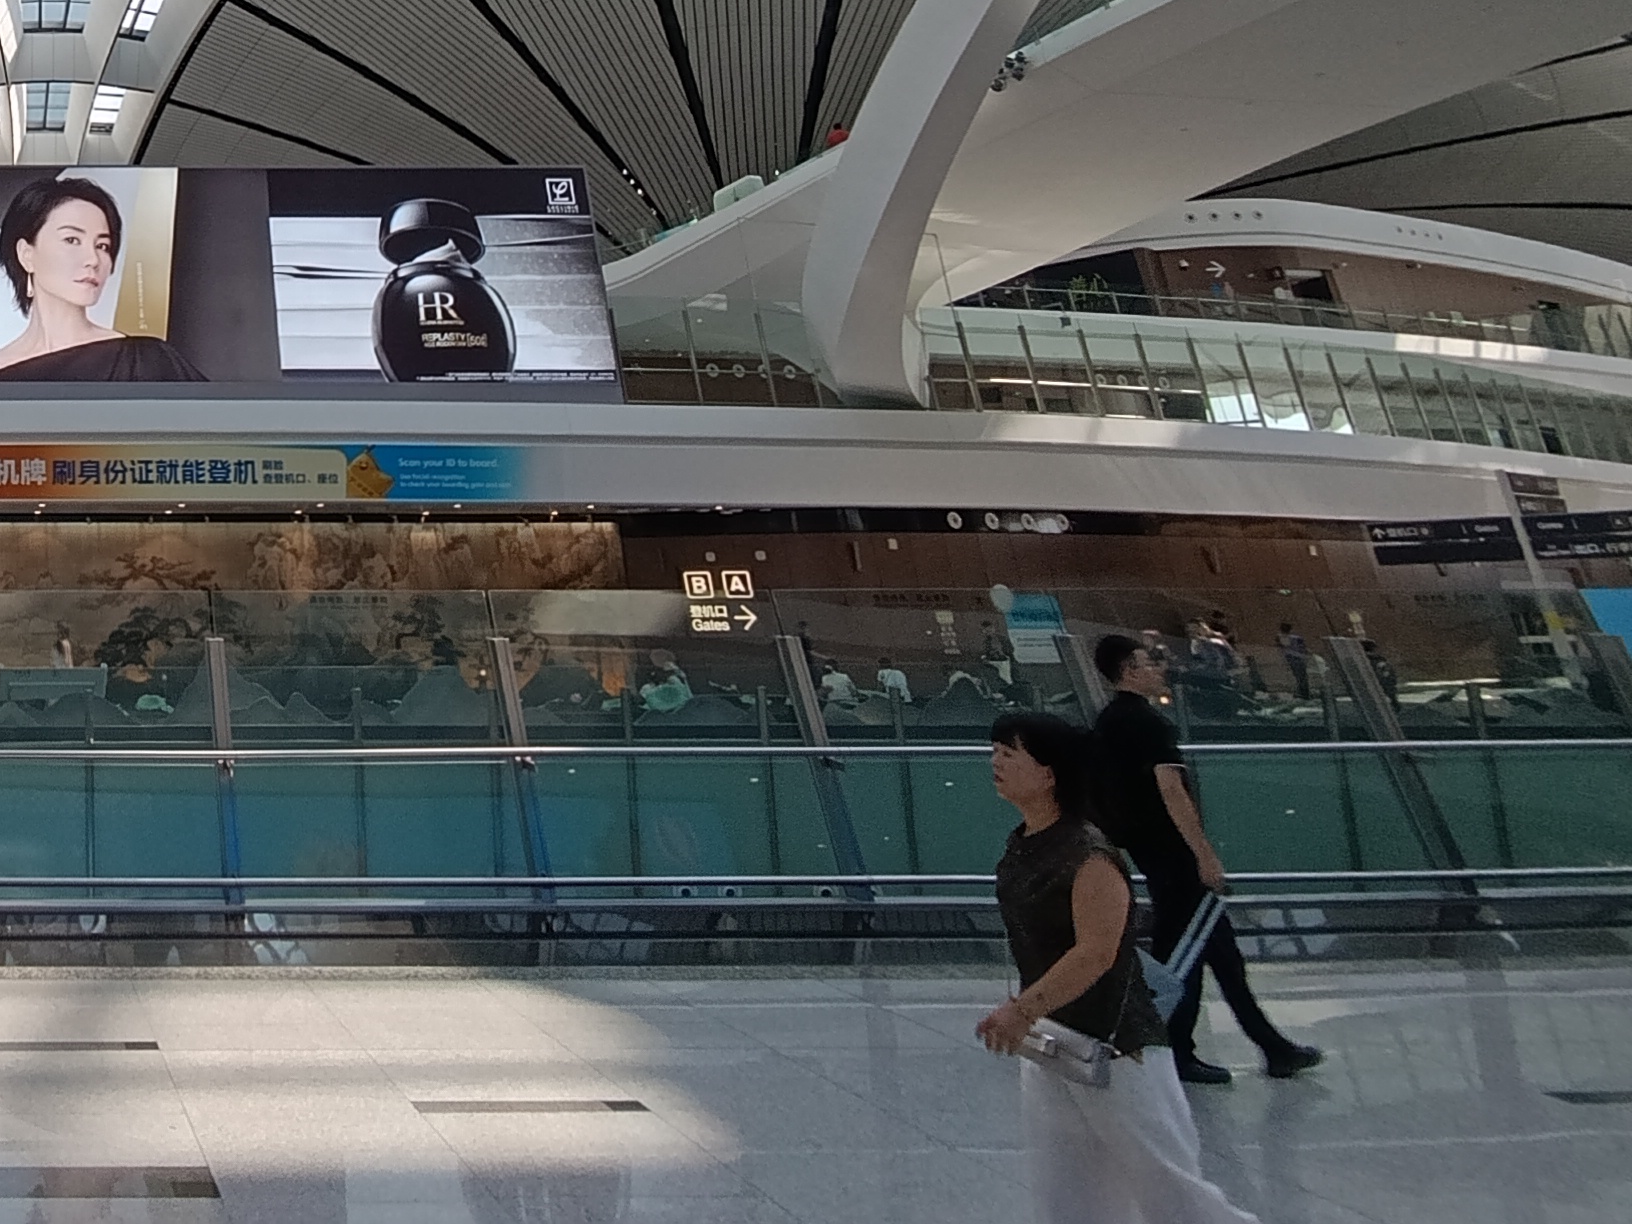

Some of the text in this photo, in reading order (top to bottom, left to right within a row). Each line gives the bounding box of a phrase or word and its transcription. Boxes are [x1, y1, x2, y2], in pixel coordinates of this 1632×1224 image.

[418, 292, 460, 321] HR
[398, 457, 420, 467] Scan
[423, 459, 443, 468] your
[446, 458, 456, 467] ID
[457, 458, 468, 467] to
[52, 459, 258, 485] 刷身份证就能登机
[690, 575, 746, 594] B A
[689, 605, 728, 617] 登机口
[691, 619, 731, 631] Gates
